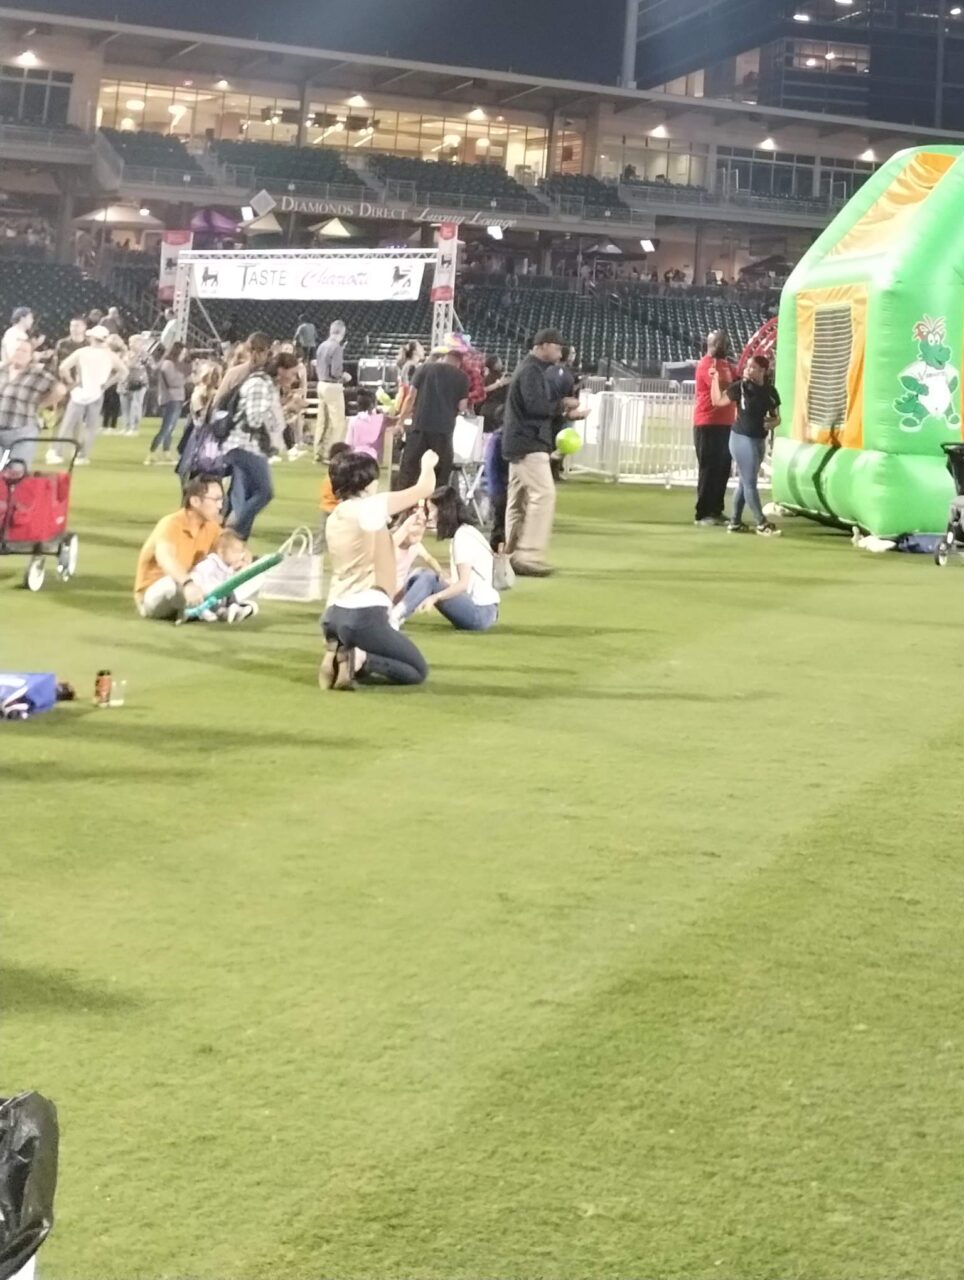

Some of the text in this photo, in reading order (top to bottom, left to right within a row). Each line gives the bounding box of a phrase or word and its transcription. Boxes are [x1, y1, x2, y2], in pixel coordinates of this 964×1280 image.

[281, 196, 518, 228] DIAMONDS DIRECT Luxury Lounge
[237, 263, 287, 292] TASTE
